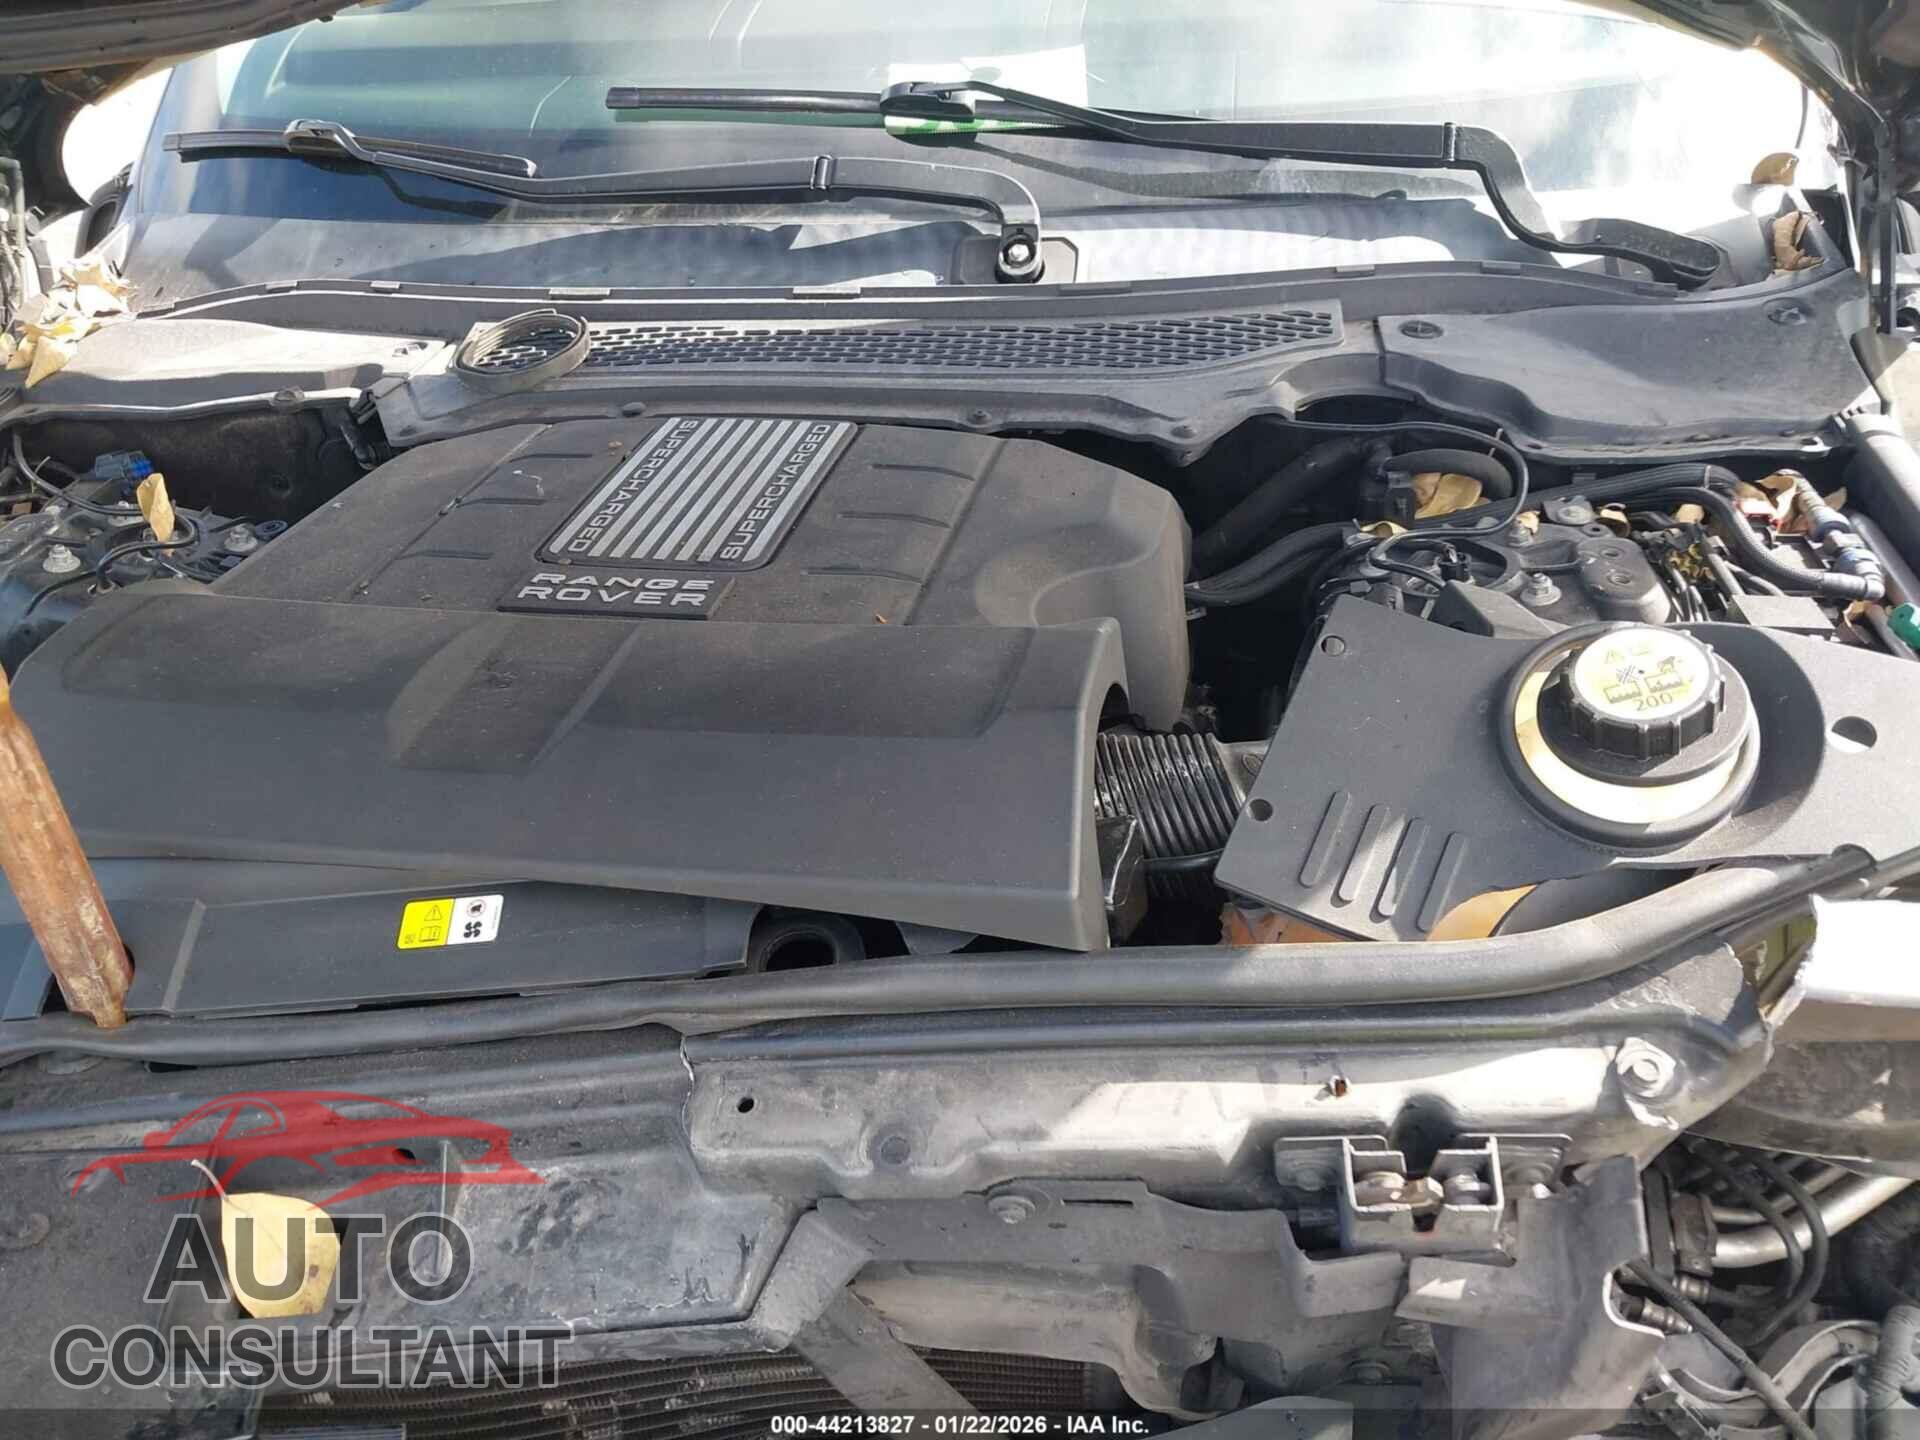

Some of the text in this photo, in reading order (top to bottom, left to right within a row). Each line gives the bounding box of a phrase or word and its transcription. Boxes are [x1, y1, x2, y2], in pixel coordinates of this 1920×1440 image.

[567, 419, 699, 552] SUPERCHARGED
[720, 423, 831, 560] SUPERCHARGED
[530, 573, 715, 590] RANGE
[517, 587, 708, 606] ROVER
[1632, 692, 1674, 712] 200
